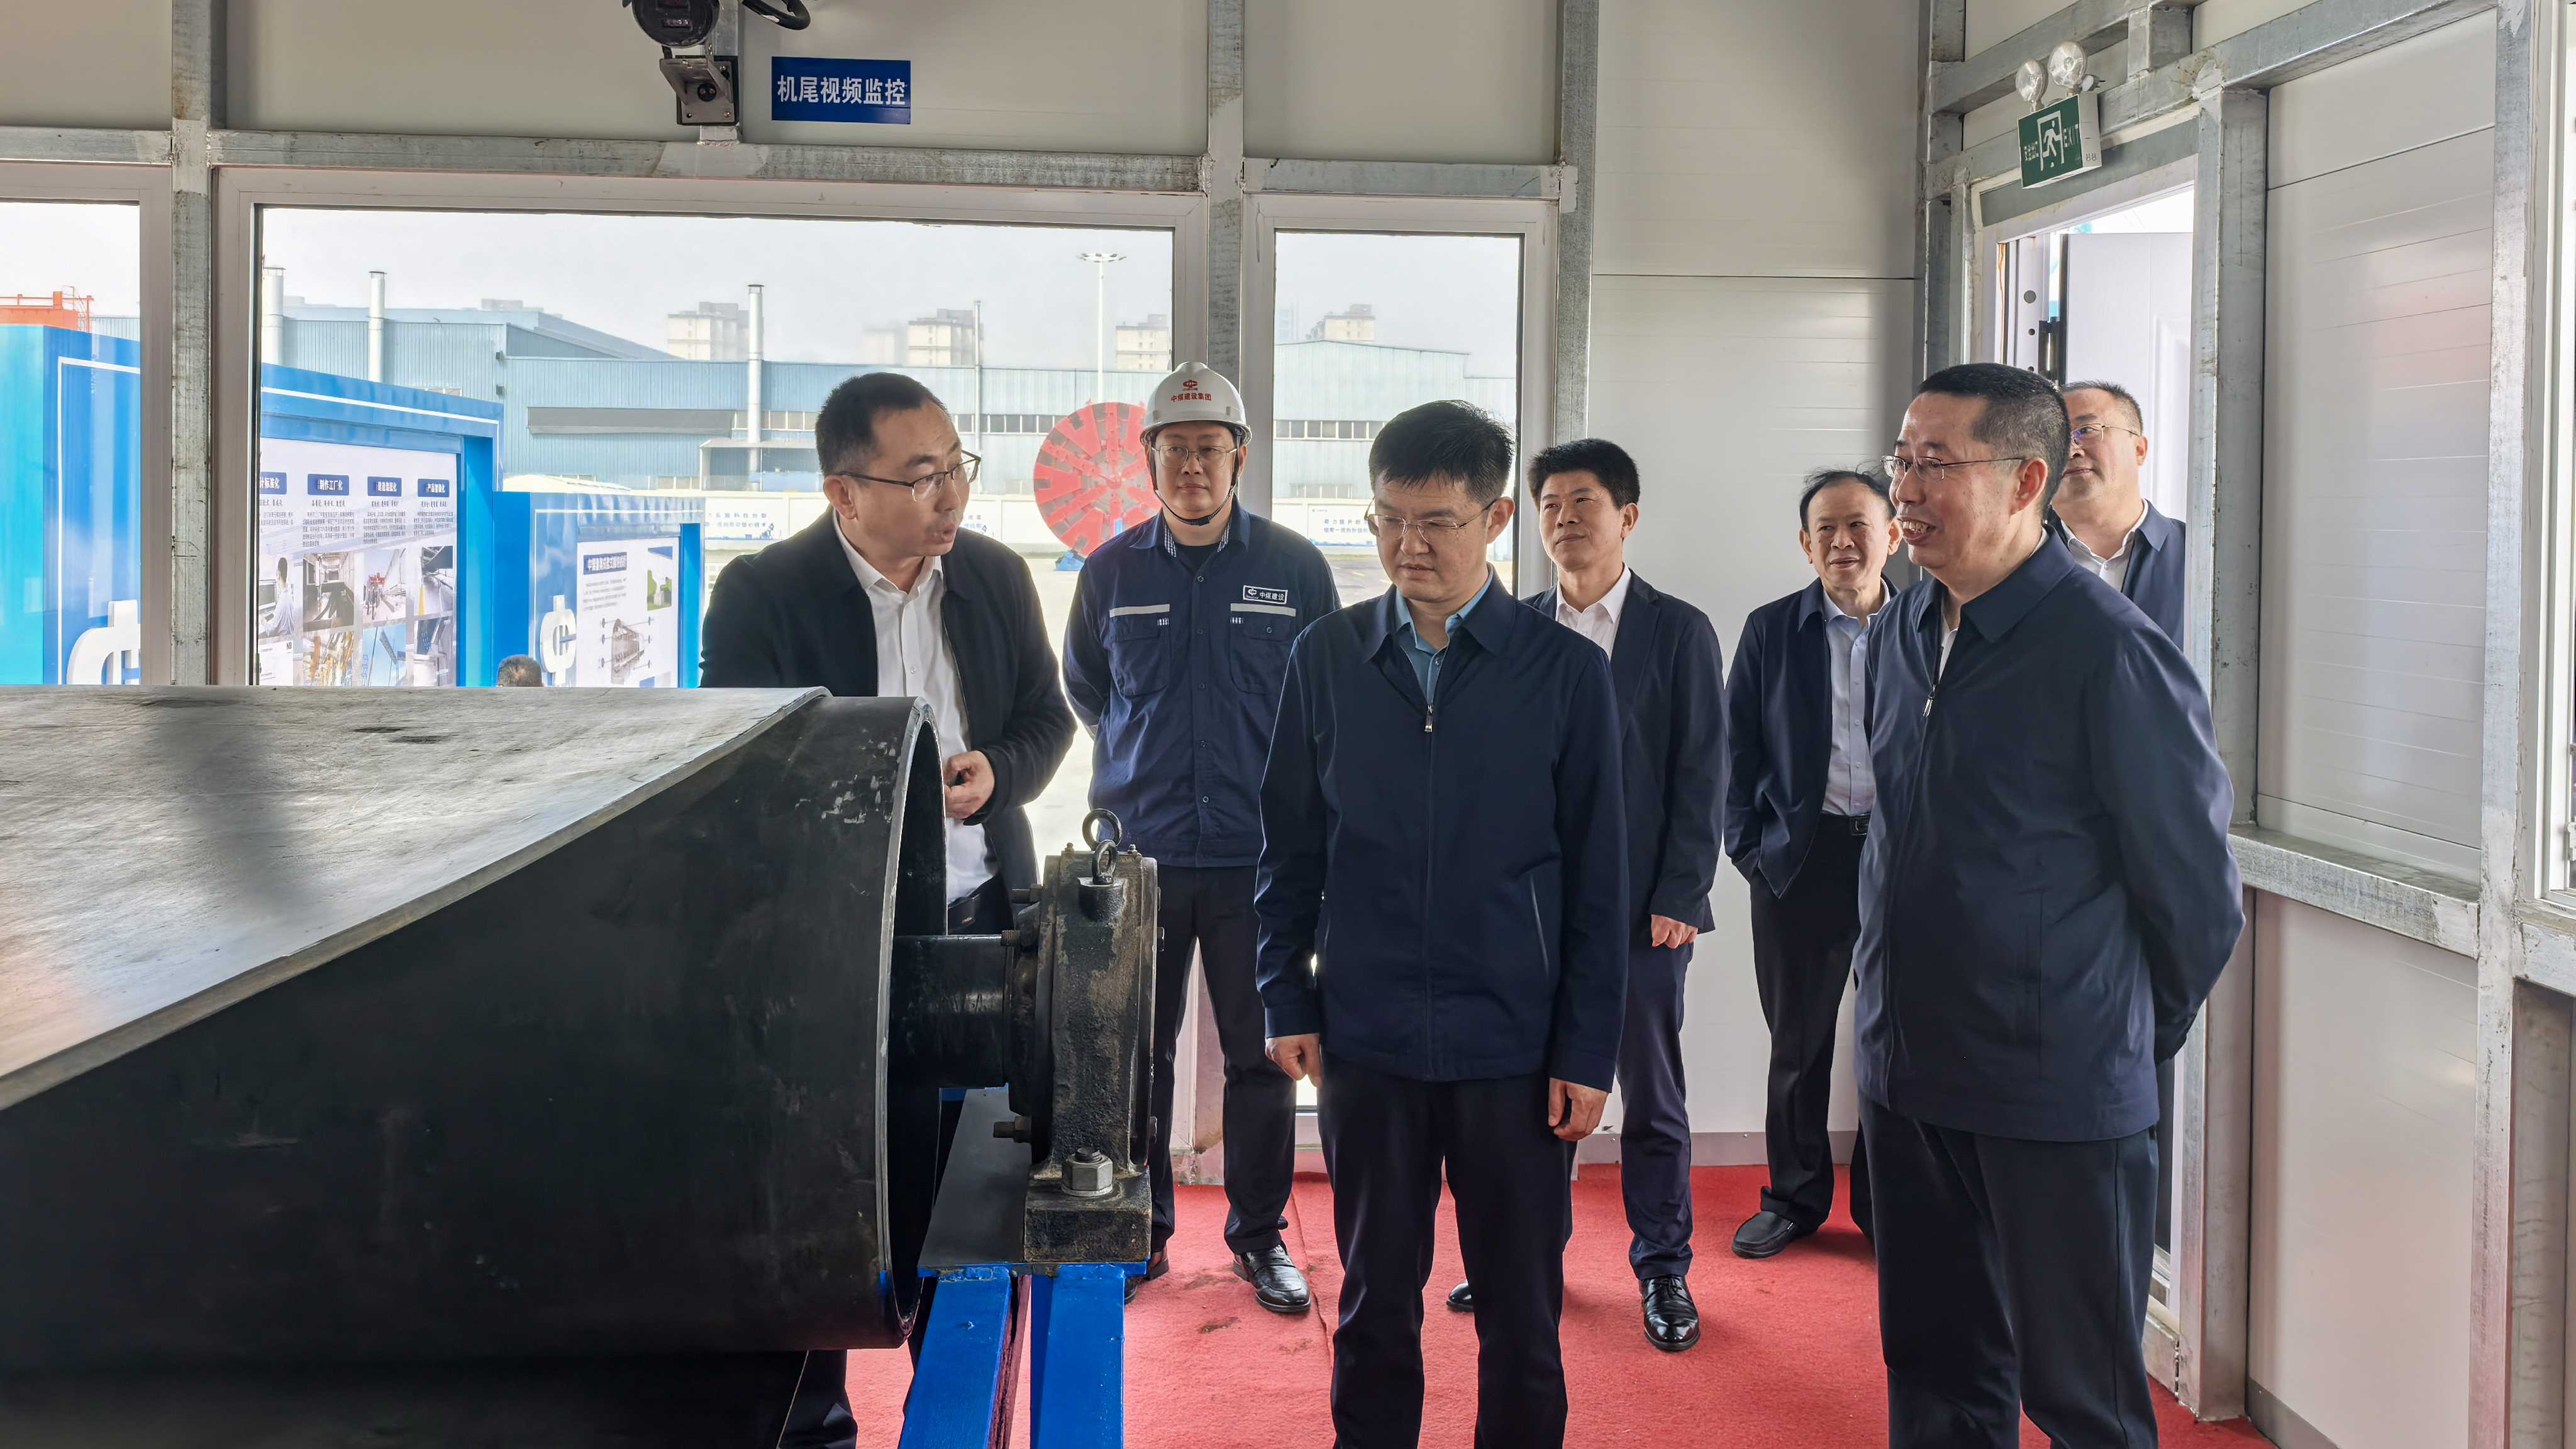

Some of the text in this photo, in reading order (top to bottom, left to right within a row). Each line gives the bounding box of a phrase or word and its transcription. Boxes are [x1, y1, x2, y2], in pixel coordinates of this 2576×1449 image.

[777, 75, 906, 105] 机尾视频监控
[2063, 124, 2079, 148] EXIT
[1171, 392, 1211, 402] 中煤建设集团
[1260, 591, 1284, 601] 中煤建设
